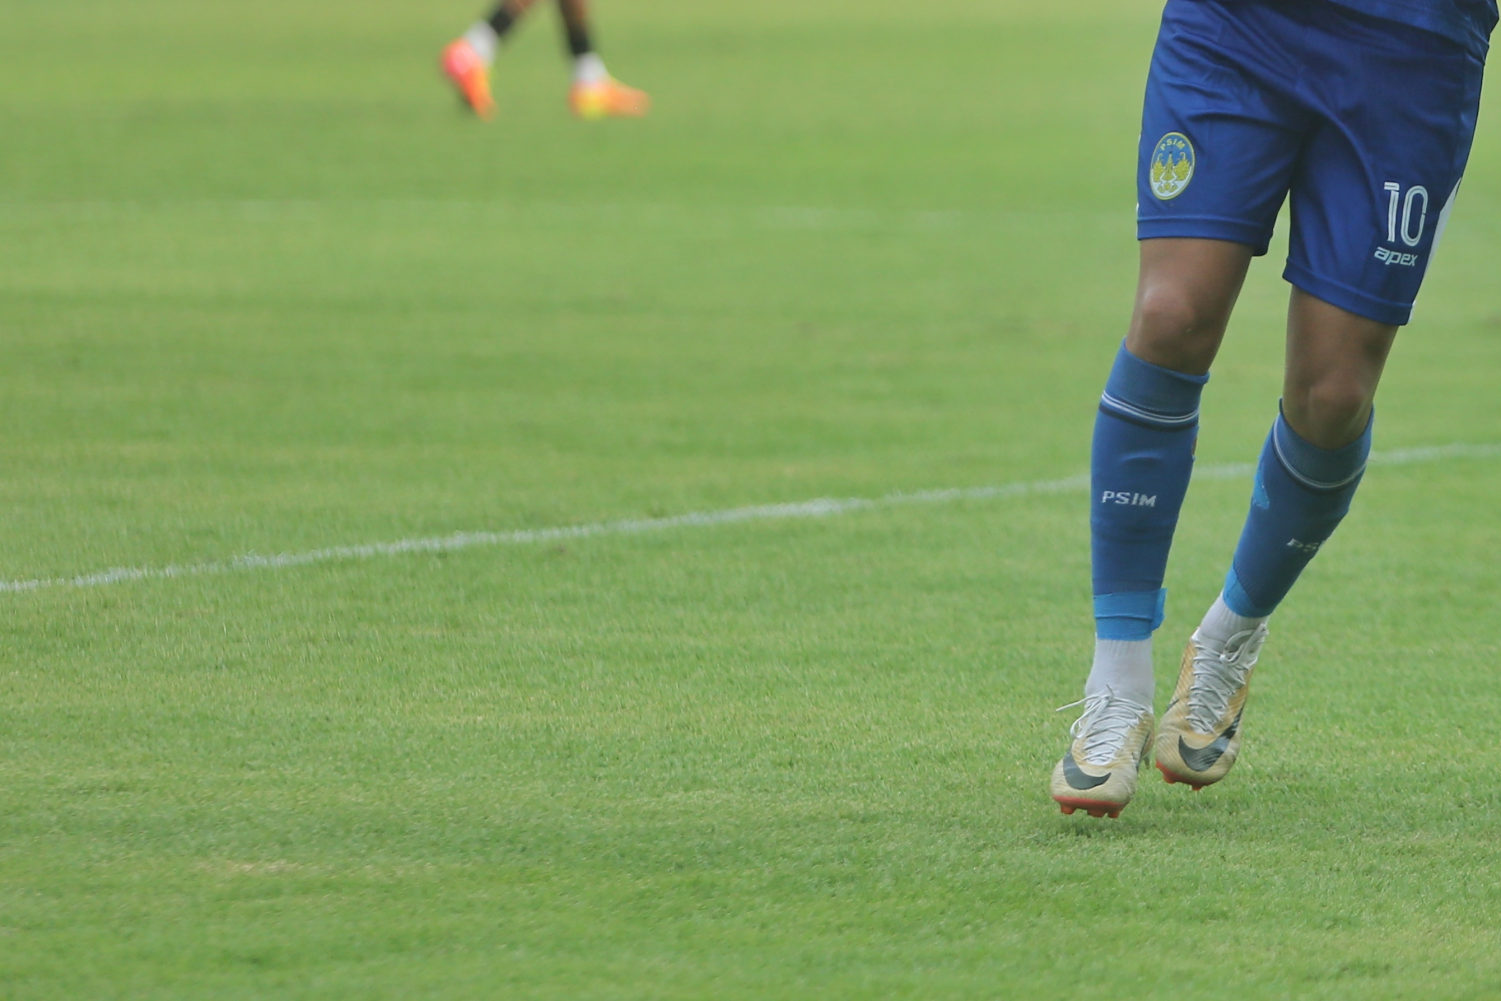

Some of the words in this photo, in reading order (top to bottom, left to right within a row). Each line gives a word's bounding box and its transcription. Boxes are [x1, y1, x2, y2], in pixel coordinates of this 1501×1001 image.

[1383, 181, 1429, 247] 10
[1373, 246, 1419, 267] apex
[1101, 490, 1157, 507] PSIM
